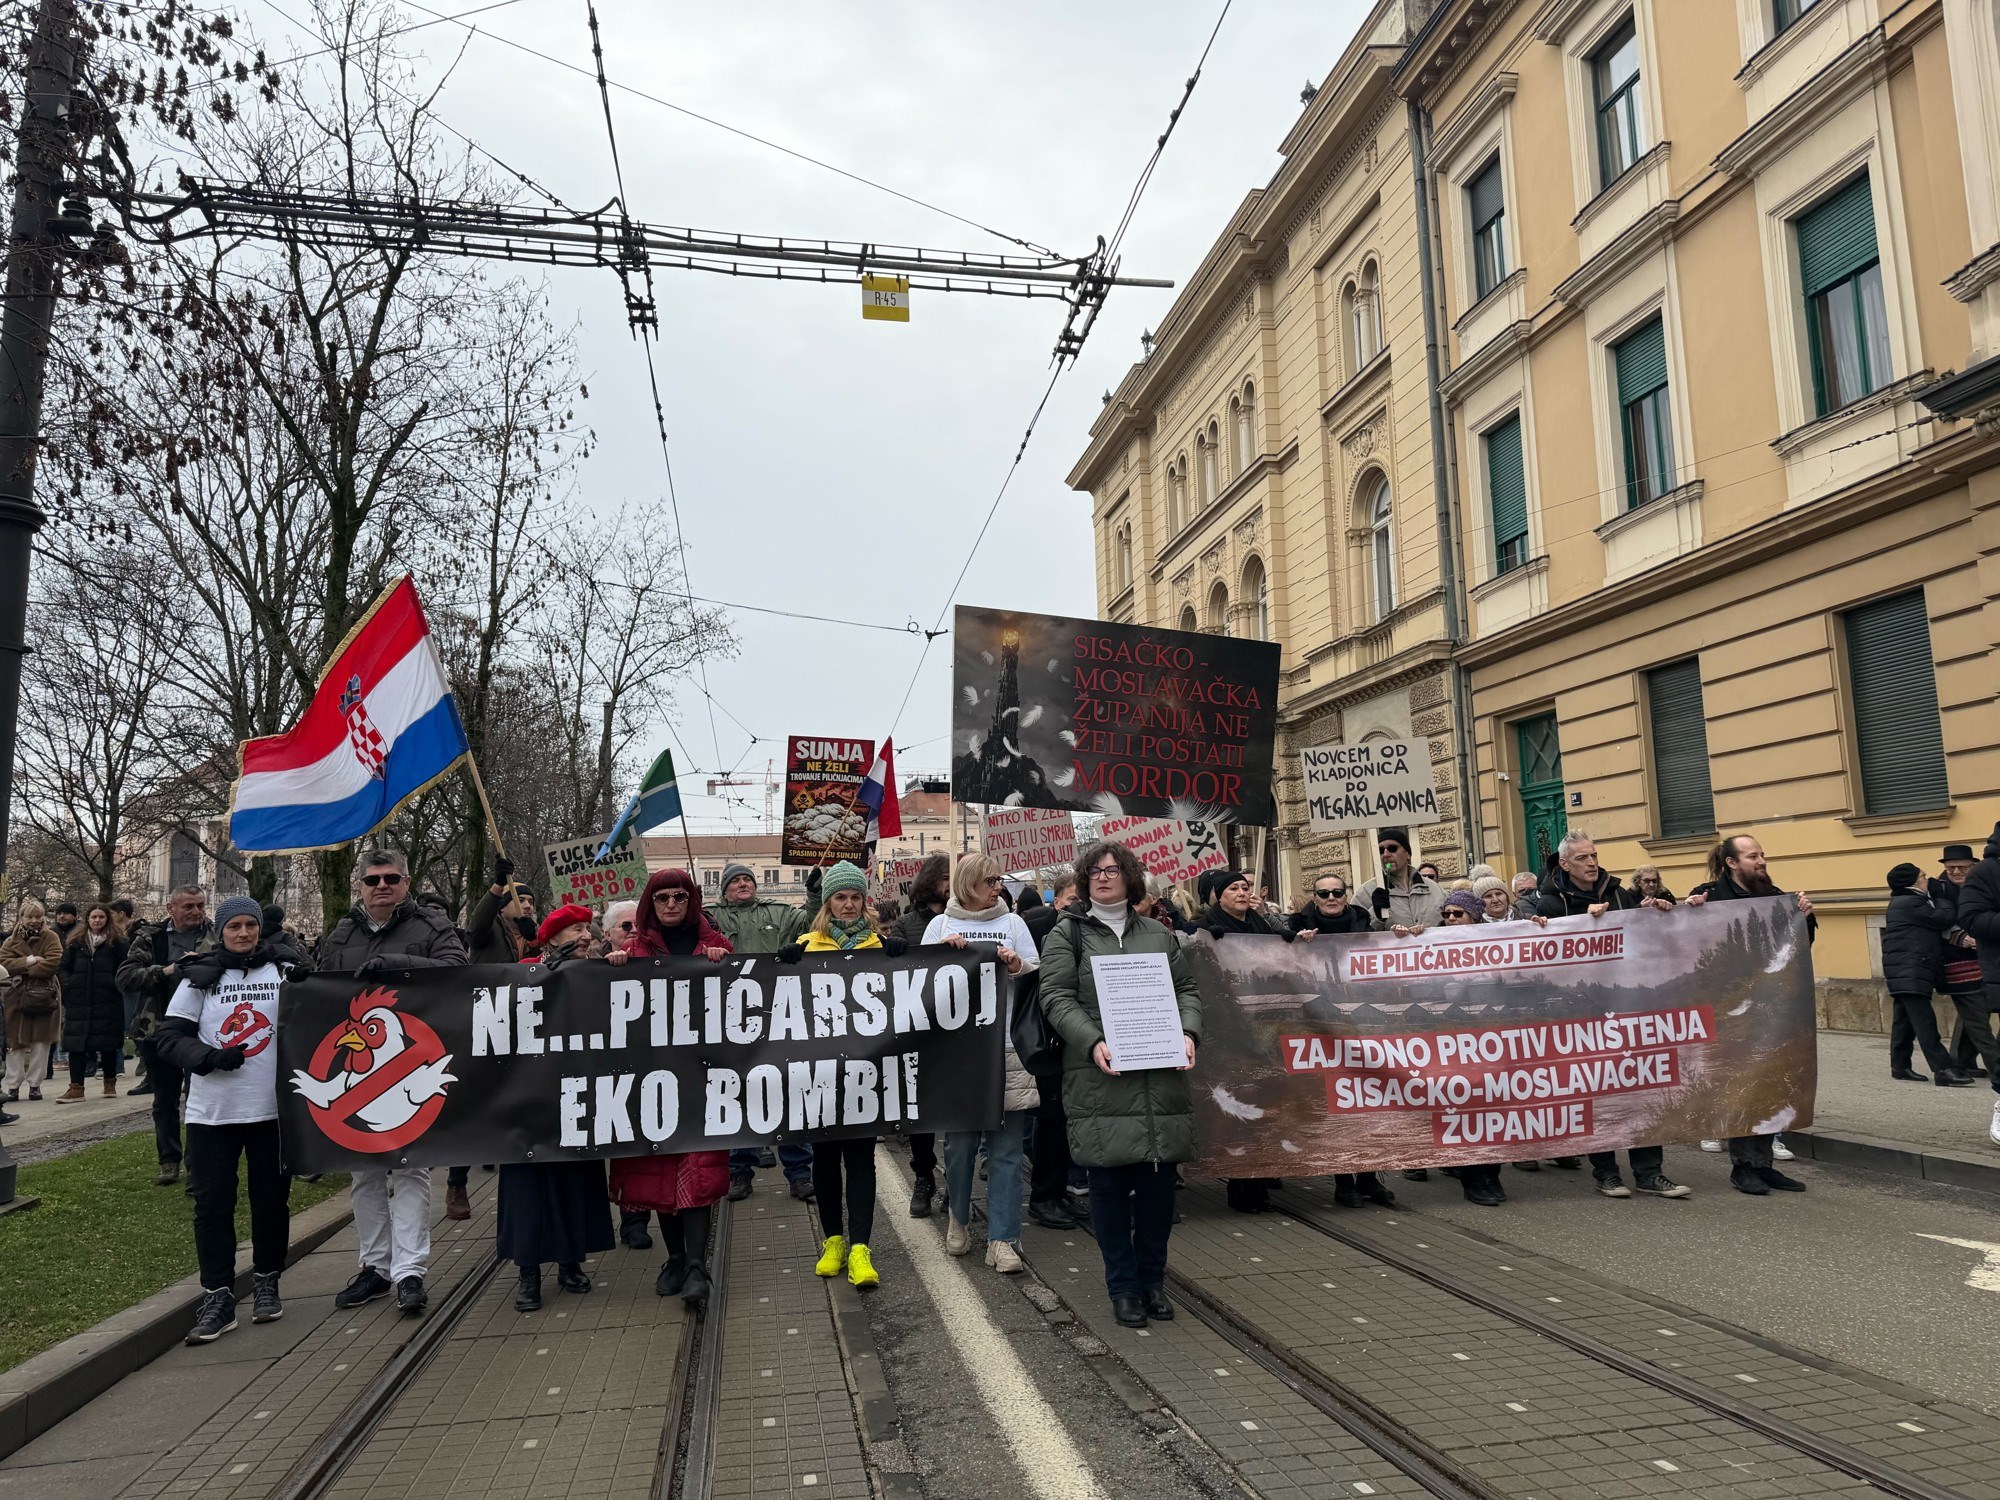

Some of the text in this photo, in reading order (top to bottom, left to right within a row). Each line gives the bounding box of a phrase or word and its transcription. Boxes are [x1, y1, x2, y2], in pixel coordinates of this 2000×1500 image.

[1074, 635, 1195, 670] SISAČKO
[1073, 666, 1262, 710] MOSLAVAČKA
[1072, 691, 1250, 738] ŽUPANIJA NE
[795, 740, 865, 762] SUNJA
[1072, 721, 1246, 768] ŽELI POSTATI
[1304, 744, 1408, 767] NOVCEM OD
[790, 773, 820, 781] TROVANJE
[806, 761, 849, 773] NE ŽELI
[1308, 758, 1409, 783] KLADIONICA
[1071, 758, 1242, 806] MORDOR
[1346, 781, 1368, 792] DO
[988, 811, 1021, 827] NITKO
[1023, 808, 1038, 822] NE
[1309, 787, 1438, 820] MEGAKLAONICA
[988, 823, 1076, 851] ŽIVJETI U SMRADU
[1172, 840, 1184, 854] U
[548, 843, 596, 866] FUCK
[555, 851, 635, 876] KAPITALISTI
[788, 849, 817, 857] SPASIMO
[1002, 844, 1074, 872] ZAGAĐENJU!
[1167, 850, 1227, 884] VODAMA
[561, 877, 636, 905] NAROD
[570, 869, 617, 889] ŽIVIO
[1350, 933, 1624, 976] NE PILIĆARSKOJ EKO BOMBI!
[220, 992, 274, 1004] EKO BOMBI!
[1288, 1011, 1708, 1070] ZAJEDNO PROTIV UNIŠTENJA
[1335, 1050, 1672, 1109] SISAČKO-MOSLAVAČKE
[560, 1052, 920, 1147] EKO BOMBI!
[1441, 1103, 1585, 1145] ŽUPANIJE
